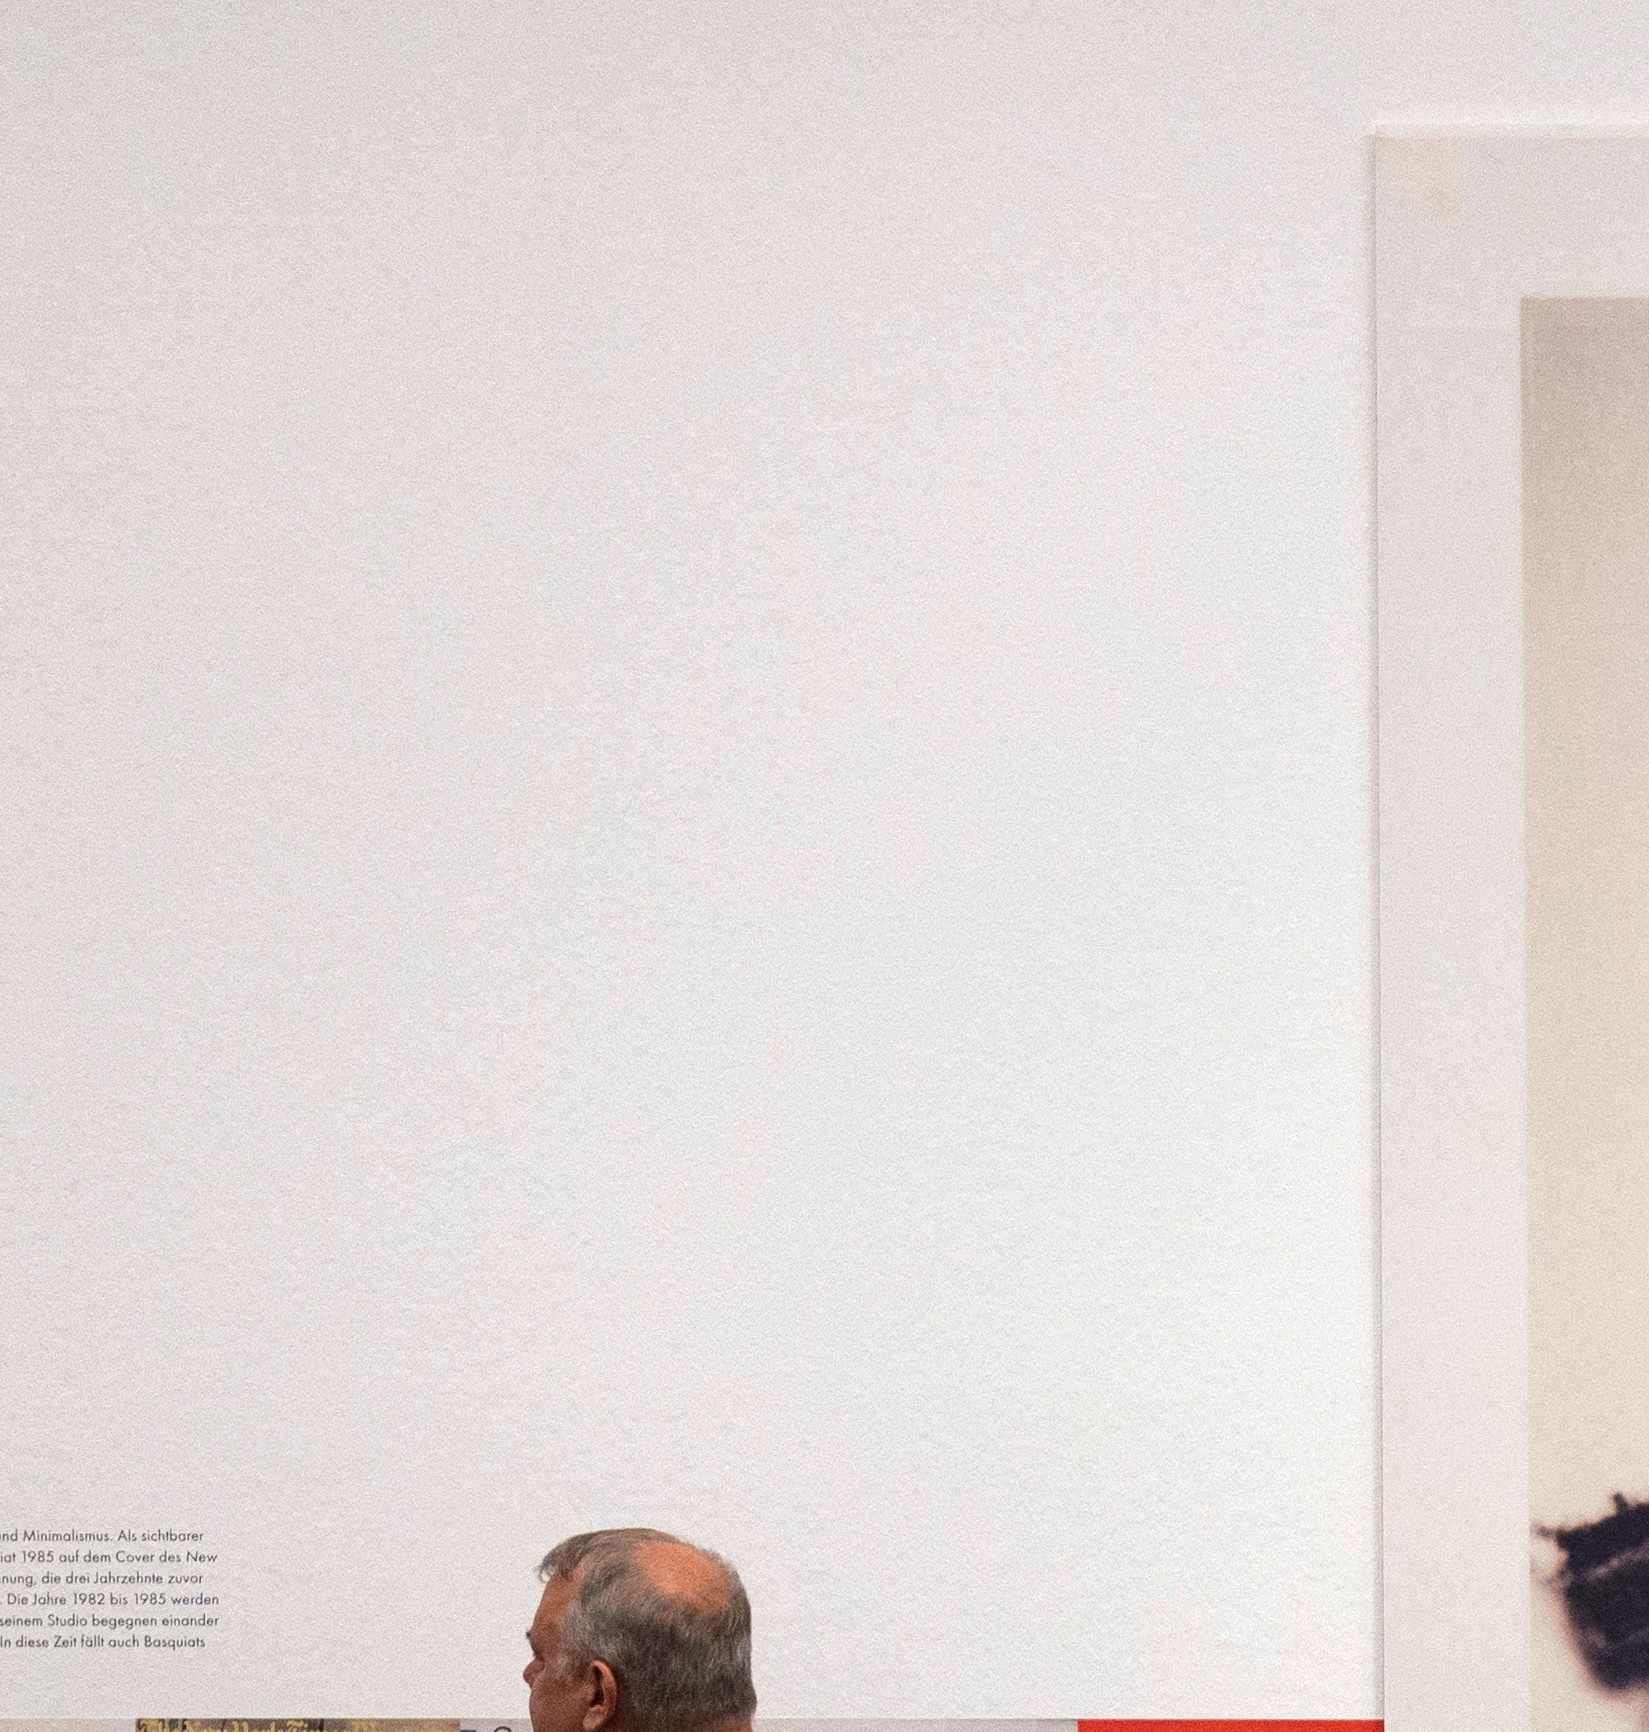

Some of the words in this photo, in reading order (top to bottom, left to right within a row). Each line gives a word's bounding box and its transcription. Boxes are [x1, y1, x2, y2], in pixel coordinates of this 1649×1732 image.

[23, 1528, 113, 1542] Minimalismus.
[117, 1528, 137, 1542] Als
[141, 1528, 204, 1542] sichtbarer
[21, 1550, 54, 1563] 1985
[58, 1550, 79, 1563] auf
[83, 1550, 111, 1563] dem
[115, 1550, 154, 1563] Cover
[159, 1550, 181, 1563] des
[186, 1550, 218, 1563] New
[41, 1571, 61, 1584] die
[65, 1571, 90, 1584] drei
[94, 1571, 163, 1584] Jahrzehnte
[168, 1574, 204, 1584] zuvor
[7, 1593, 28, 1606] Die
[32, 1593, 67, 1606] Jahre
[72, 1593, 105, 1606] 1982
[110, 1593, 128, 1606] bis
[134, 1593, 166, 1606] 1985
[170, 1593, 219, 1606] werden
[48, 1614, 88, 1627] Studio
[92, 1614, 157, 1630] begegnen
[161, 1614, 219, 1627] einander
[15, 1635, 49, 1648] diese
[53, 1635, 77, 1648] Zeit
[80, 1635, 105, 1648] fällt
[108, 1635, 140, 1648] auch
[144, 1635, 206, 1651] Basquiats
